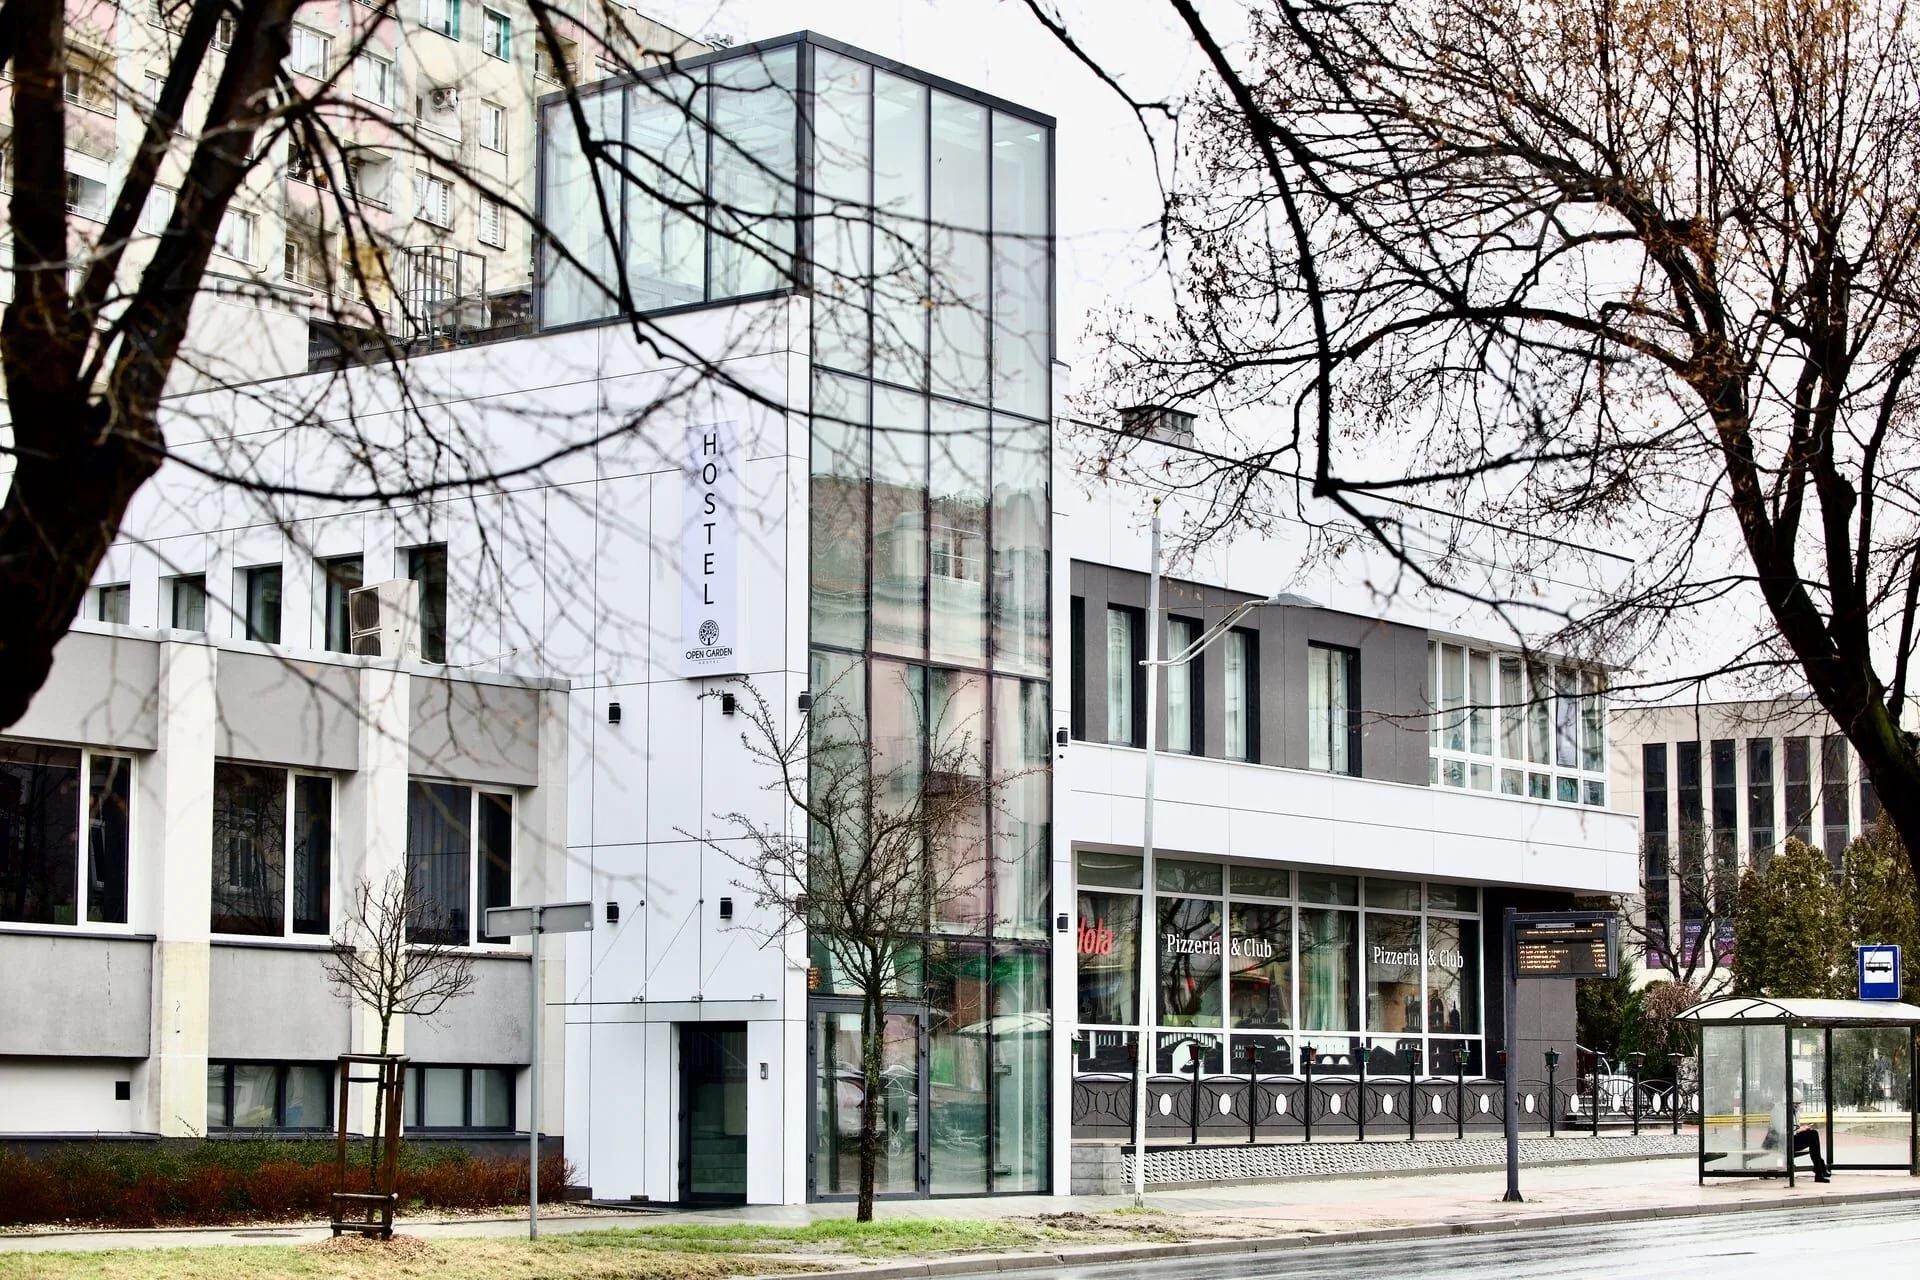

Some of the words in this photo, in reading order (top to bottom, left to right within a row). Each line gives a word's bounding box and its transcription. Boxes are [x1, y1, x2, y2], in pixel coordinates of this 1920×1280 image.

[703, 433, 717, 605] HOSTEL
[685, 650, 704, 660] OPEN
[706, 647, 733, 658] GARDEN
[1167, 933, 1221, 955] Pizzeria
[1231, 937, 1241, 956] &
[1243, 938, 1272, 958] Club
[1373, 946, 1419, 966] Pizzeria
[1428, 949, 1437, 966] &
[1440, 949, 1464, 968] Club
